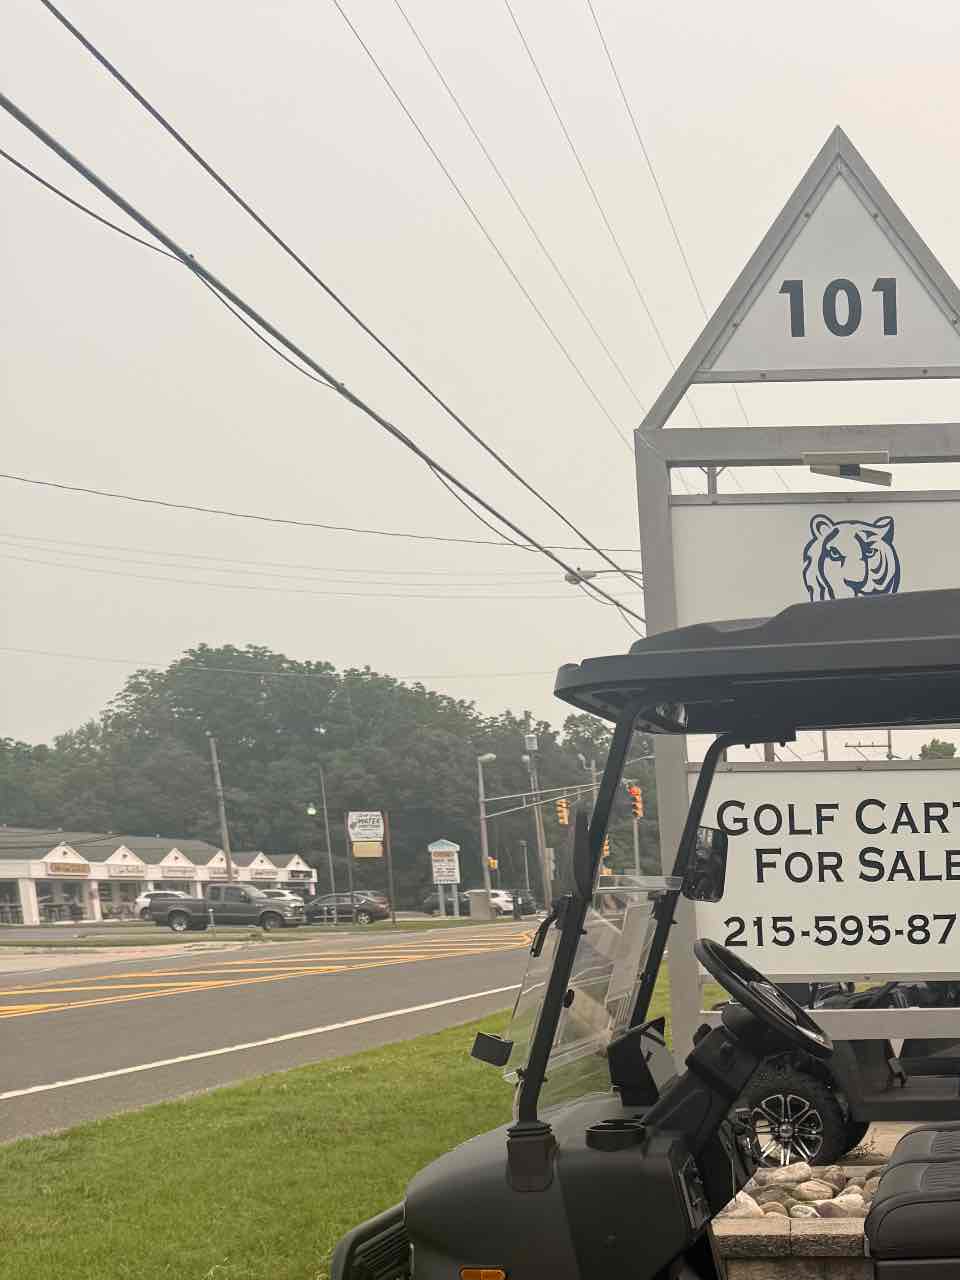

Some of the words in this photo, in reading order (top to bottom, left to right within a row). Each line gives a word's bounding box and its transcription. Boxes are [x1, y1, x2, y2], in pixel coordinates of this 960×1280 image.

[779, 278, 897, 337] 101
[717, 800, 839, 835] GOLF
[755, 847, 844, 883] FOR
